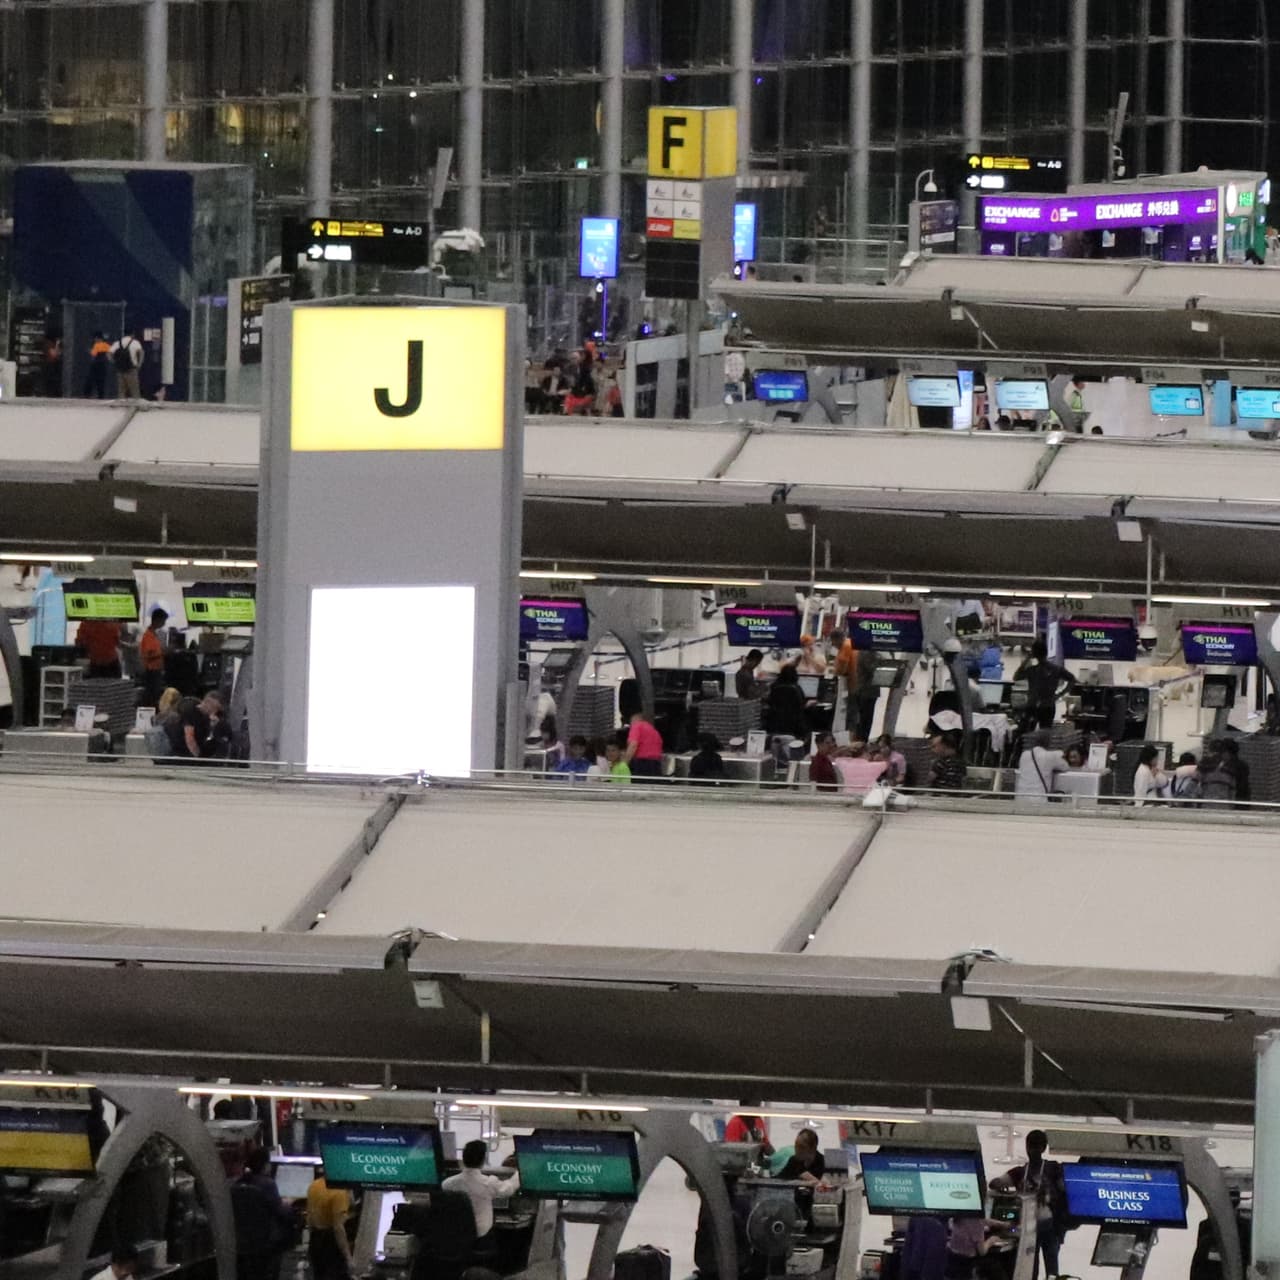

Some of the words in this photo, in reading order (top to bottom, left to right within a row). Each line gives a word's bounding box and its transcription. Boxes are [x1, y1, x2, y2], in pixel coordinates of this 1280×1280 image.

[662, 116, 687, 169] F
[984, 206, 1041, 218] EXCHANGE
[1095, 202, 1143, 219] EXCHANGE
[374, 340, 423, 418] J
[719, 587, 747, 599] H08
[887, 593, 914, 604] H09
[1056, 600, 1084, 610] H10
[535, 609, 558, 618] THAI
[1223, 606, 1250, 616] H11
[748, 618, 770, 626] THAI
[869, 622, 892, 630] THAI
[1083, 631, 1105, 639] THAI
[1205, 636, 1227, 644] THAI
[853, 1121, 897, 1137] K17
[1126, 1134, 1172, 1151] K18
[351, 1152, 407, 1165] ECONOMY
[363, 1164, 399, 1175] CLASS
[547, 1161, 603, 1174] ECONOMY
[559, 1173, 594, 1184] CLASS
[1098, 1188, 1150, 1201] BUSINESS
[1108, 1200, 1143, 1211] CLASS
